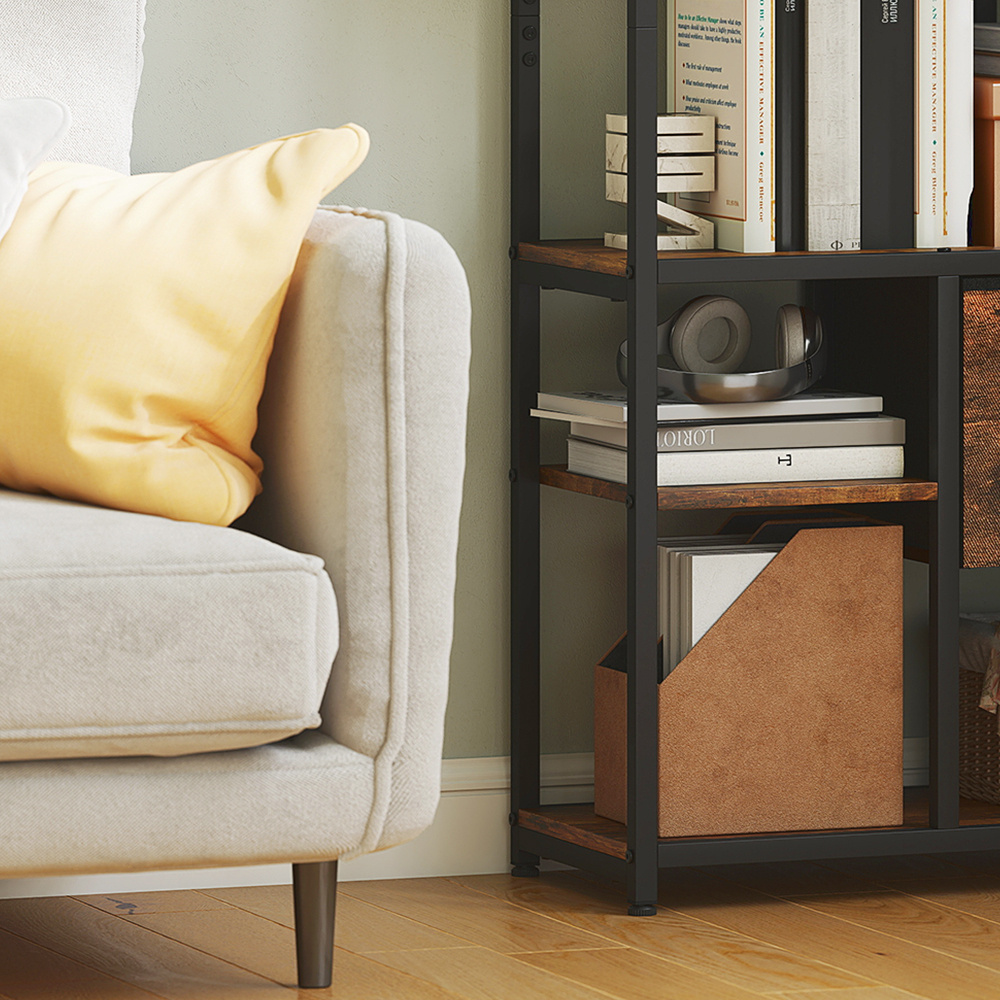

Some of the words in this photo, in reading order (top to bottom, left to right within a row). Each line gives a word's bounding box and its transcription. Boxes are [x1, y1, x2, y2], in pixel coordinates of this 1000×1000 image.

[760, 9, 765, 21] BE
[932, 6, 937, 20] AN
[760, 25, 765, 38] AN
